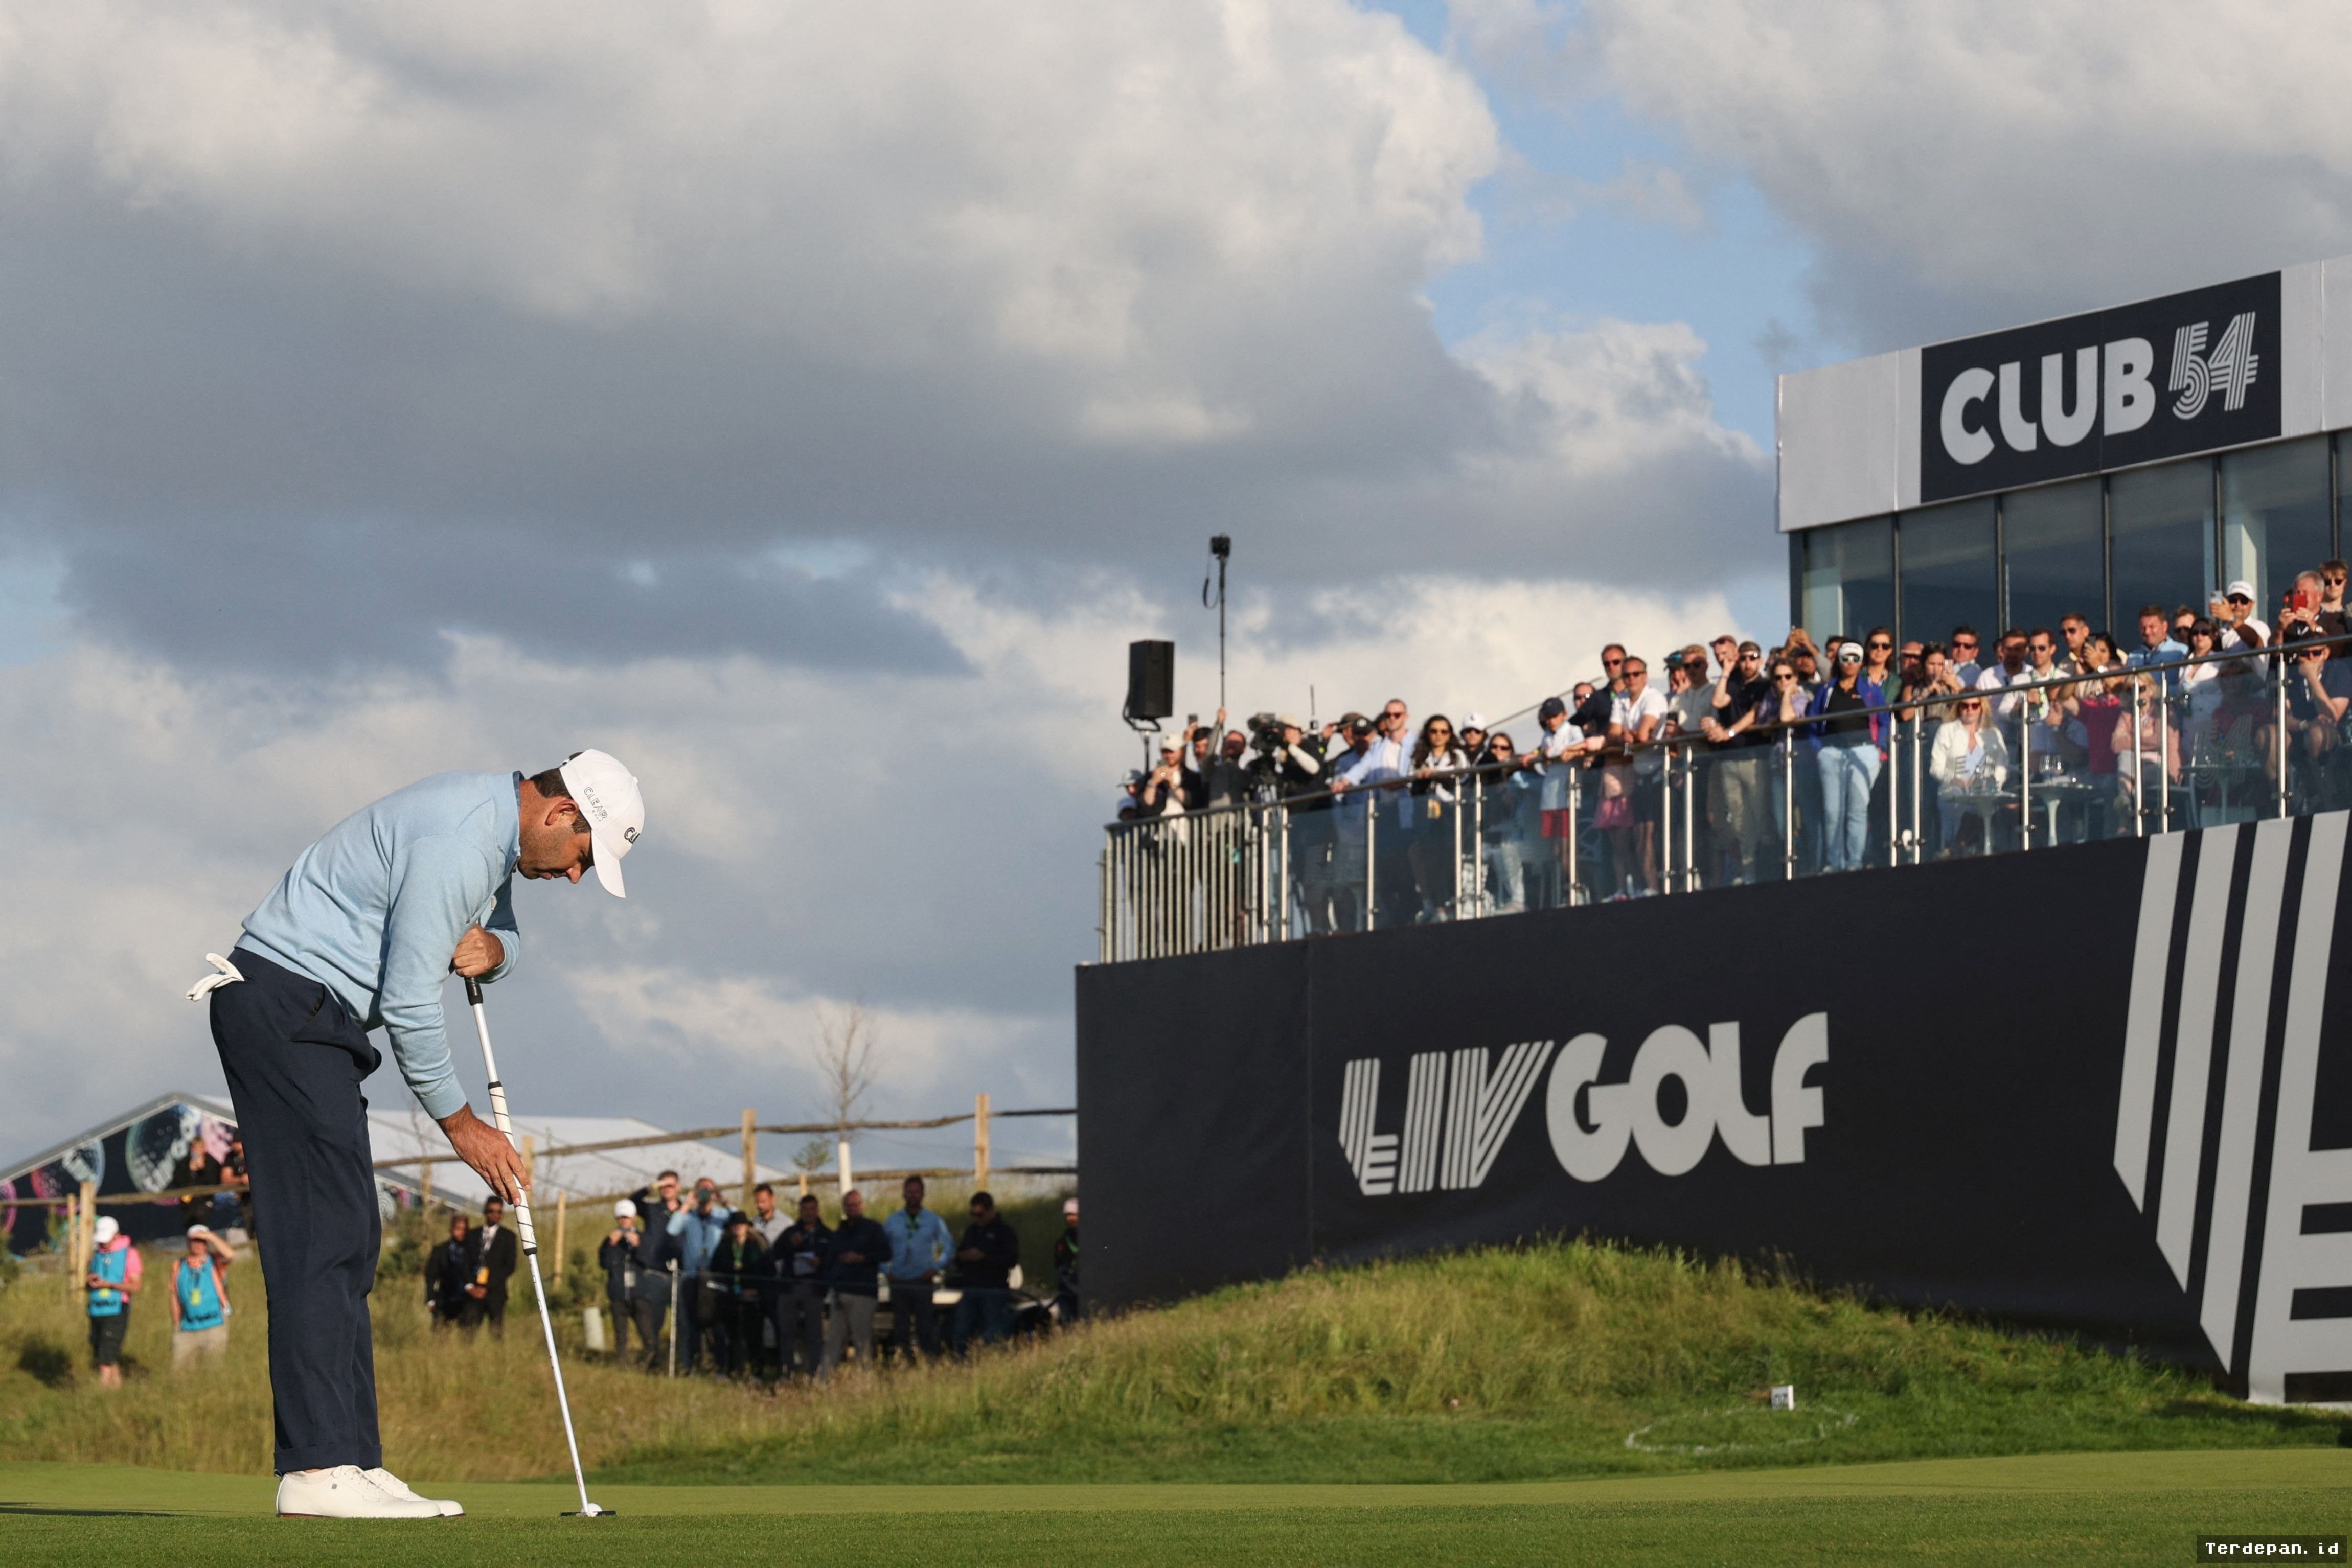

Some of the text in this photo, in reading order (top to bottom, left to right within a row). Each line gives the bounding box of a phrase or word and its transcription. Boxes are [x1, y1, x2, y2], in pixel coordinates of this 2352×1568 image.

[1940, 311, 2259, 465] CLUB 54
[584, 787, 608, 820] CLEAR
[1338, 1040, 1555, 1196] LIV
